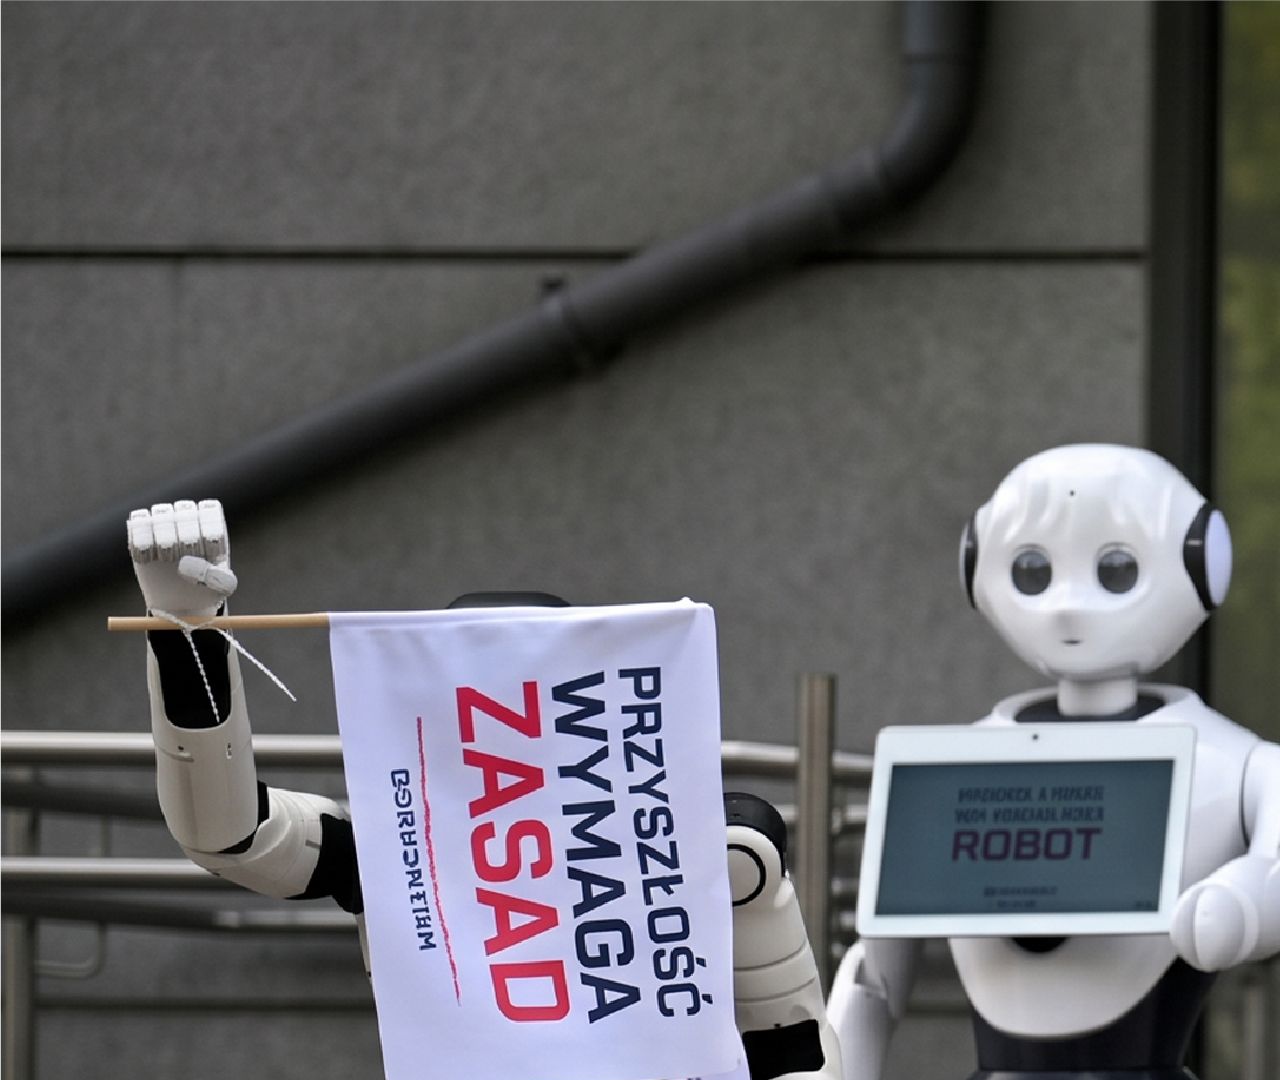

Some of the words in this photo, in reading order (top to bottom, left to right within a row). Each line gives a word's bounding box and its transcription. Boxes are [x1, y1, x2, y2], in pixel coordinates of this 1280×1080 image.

[456, 681, 571, 1023] ZASAD
[551, 671, 642, 1025] WYMAGA
[618, 666, 714, 1018] PRZYSZŁOŚĆ
[952, 828, 1103, 862] ROBOT
